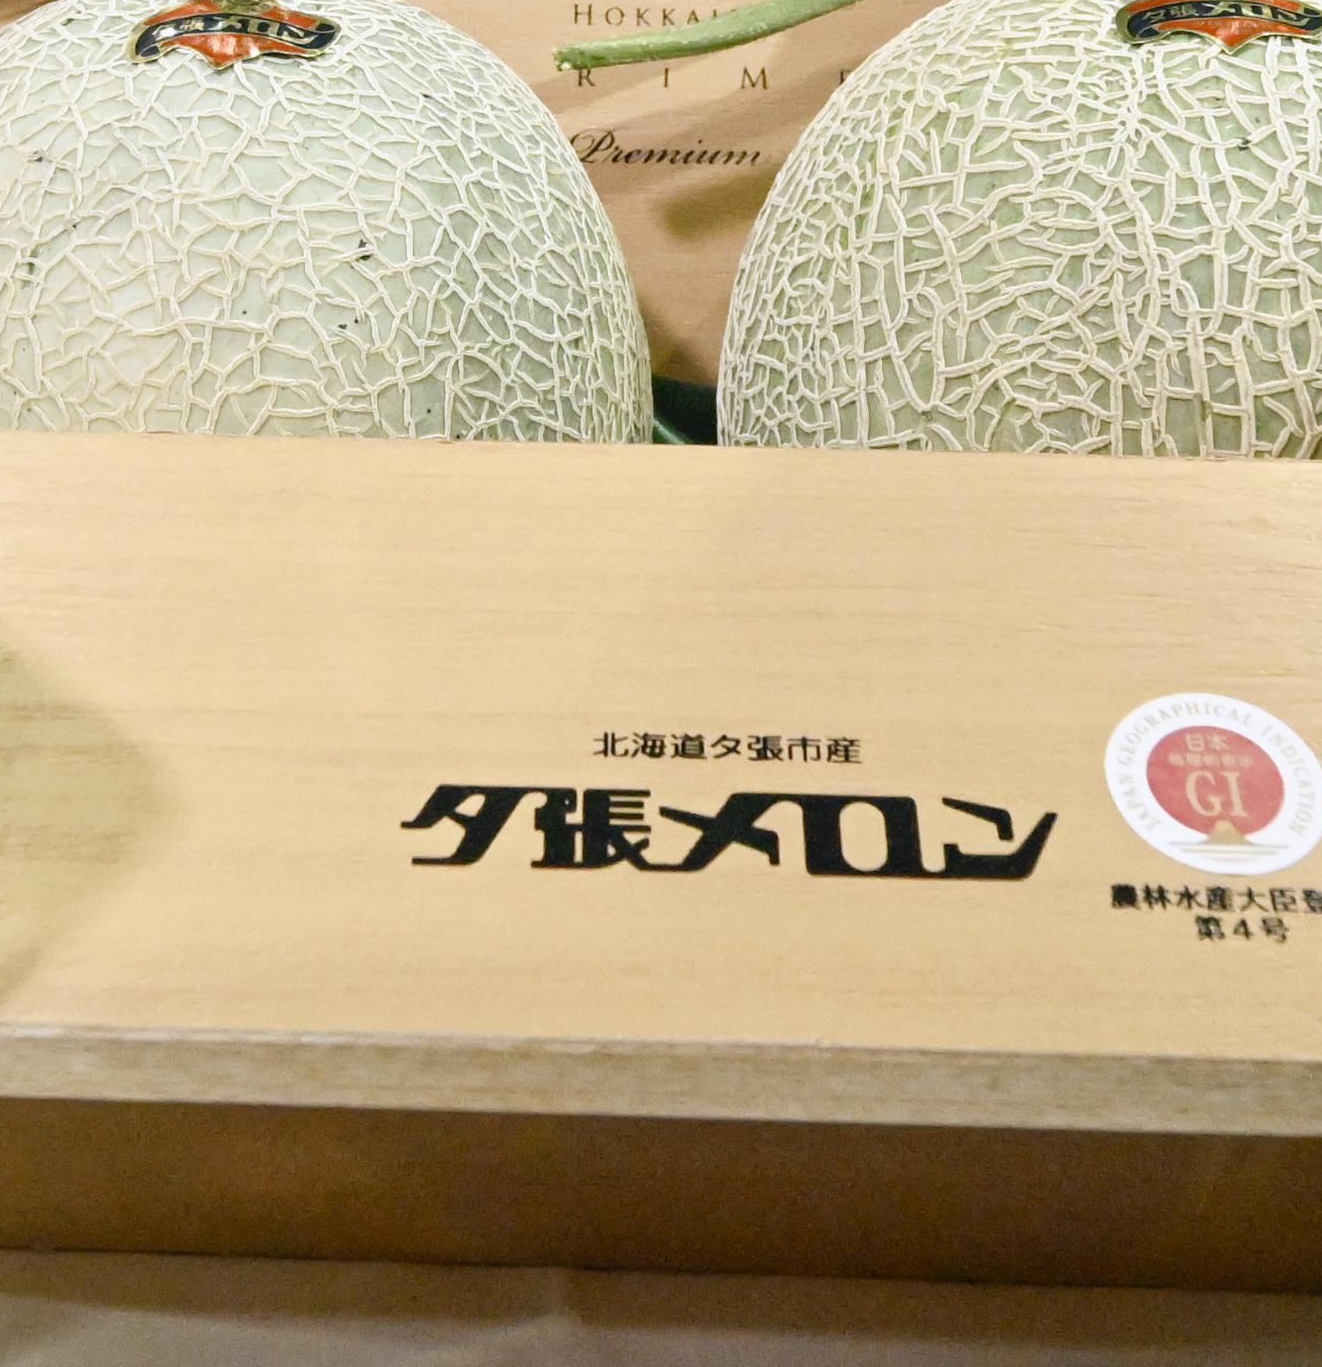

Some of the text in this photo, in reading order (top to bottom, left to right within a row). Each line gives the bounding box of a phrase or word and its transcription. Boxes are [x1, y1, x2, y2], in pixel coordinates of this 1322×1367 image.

[573, 3, 735, 27] HOKKAI
[569, 128, 761, 166] Premium
[592, 731, 863, 765] 北海道夕張市産
[1185, 770, 1248, 817] GI
[400, 783, 1058, 881] 夕張メロン
